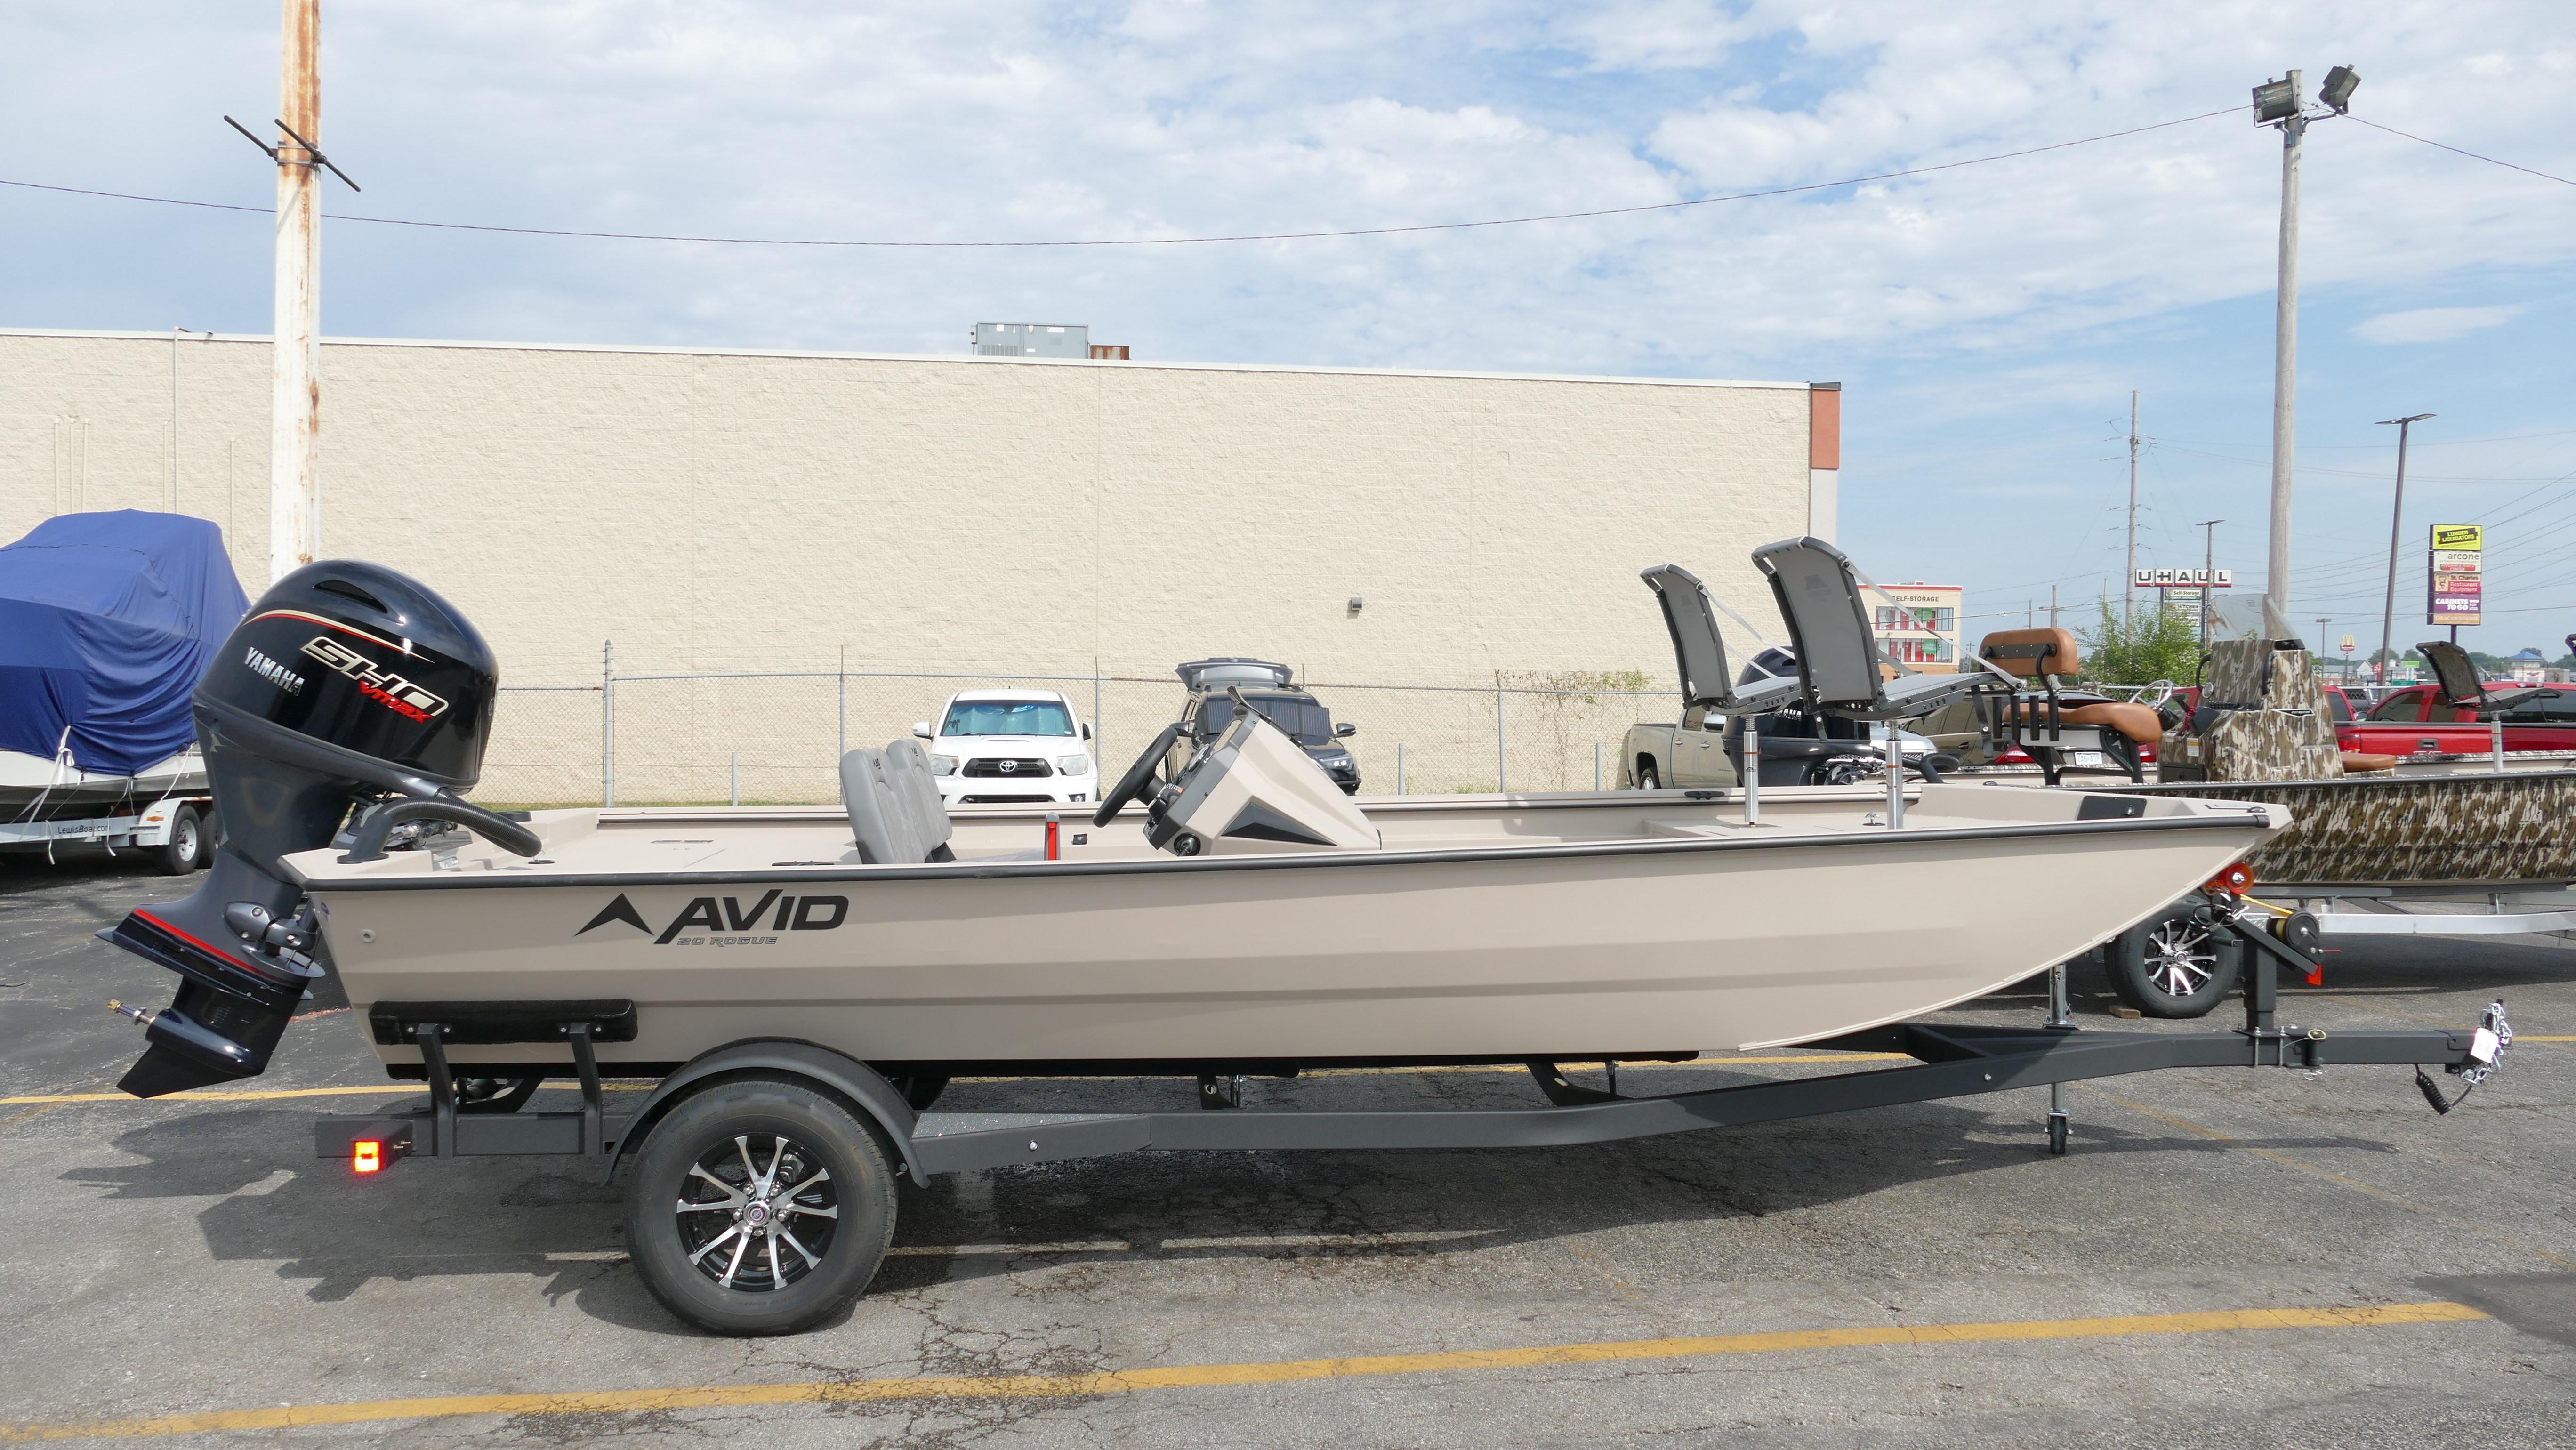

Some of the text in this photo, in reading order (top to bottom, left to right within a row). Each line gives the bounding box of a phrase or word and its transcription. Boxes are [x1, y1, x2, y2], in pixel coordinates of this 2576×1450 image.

[244, 646, 305, 696] YAMAHA
[300, 636, 449, 717] SHO
[654, 889, 849, 944] AVID
[677, 936, 778, 947] 20 ROGUE
